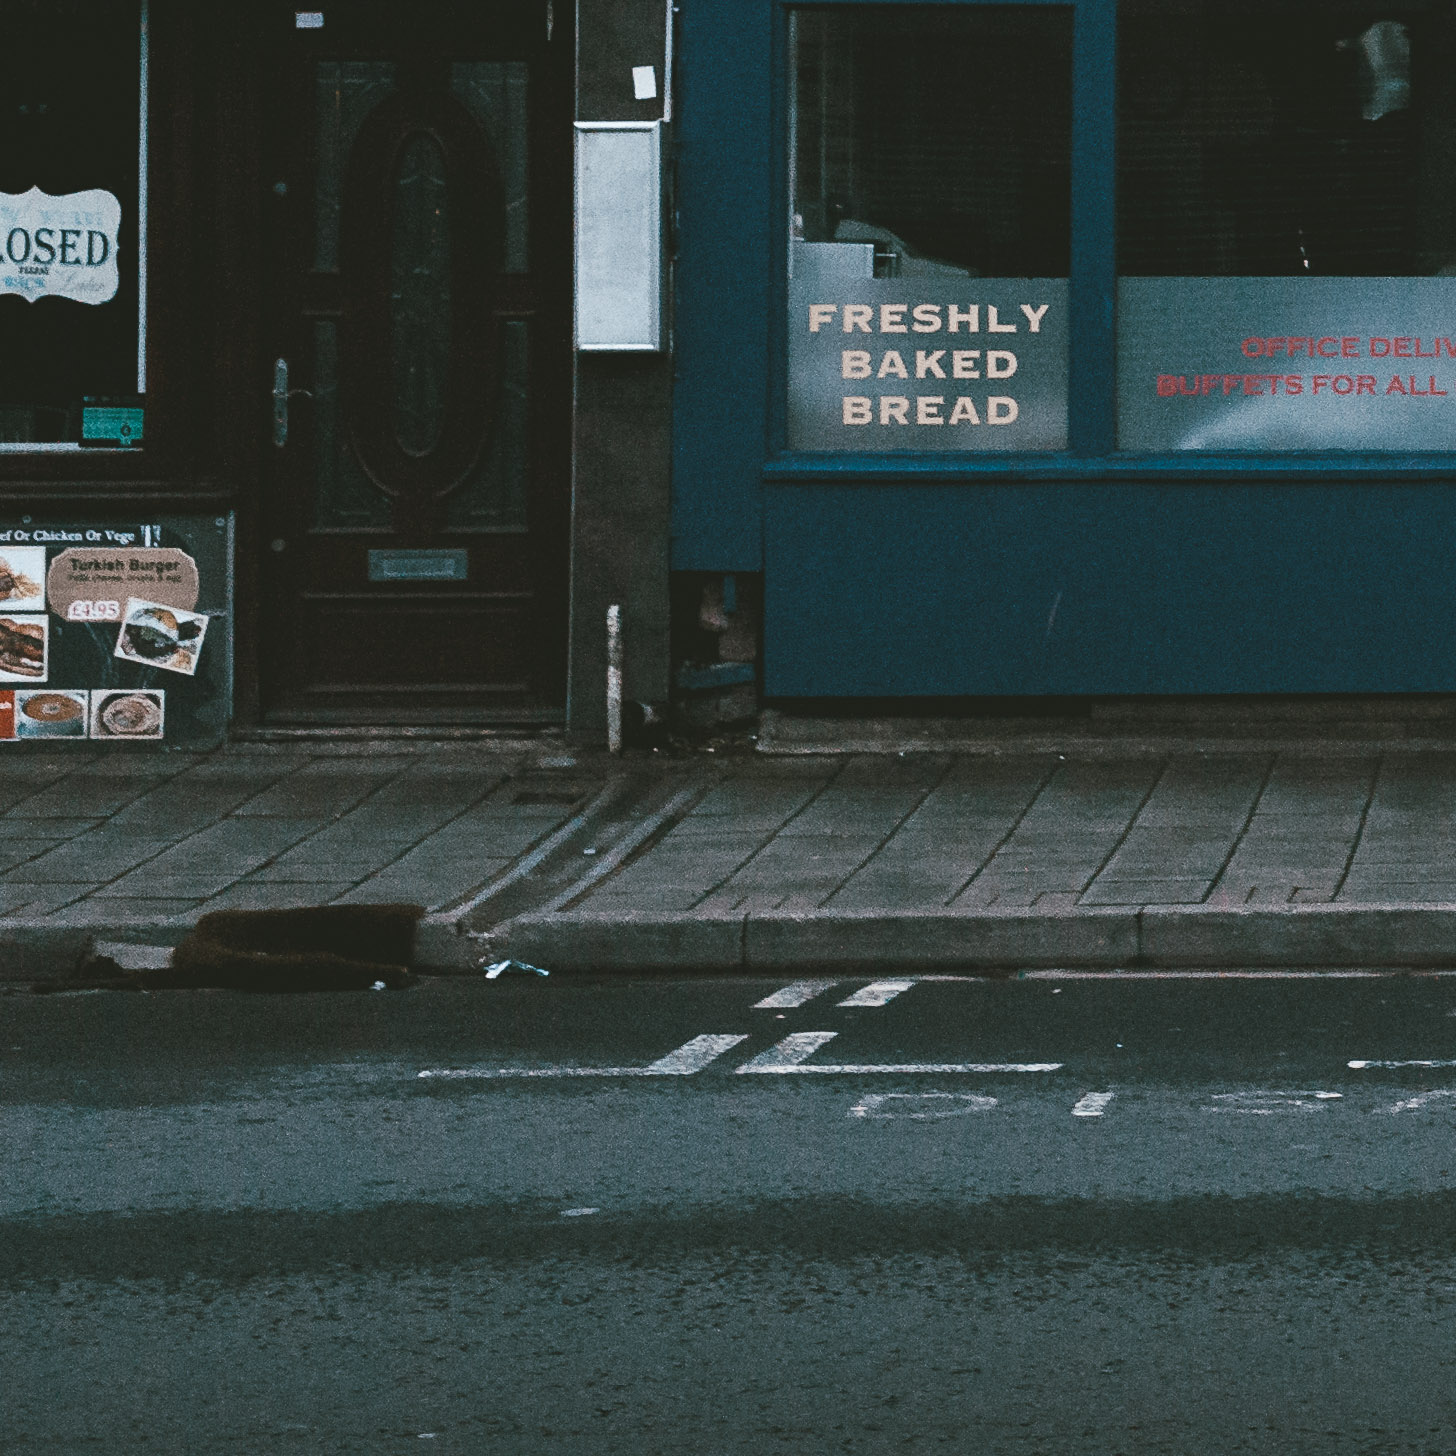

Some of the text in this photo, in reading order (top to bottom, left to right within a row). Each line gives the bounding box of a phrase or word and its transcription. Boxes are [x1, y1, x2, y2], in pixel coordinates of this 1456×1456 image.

[0, 227, 111, 267] OSED
[808, 303, 1049, 333] FRESHLY
[1240, 336, 1360, 359] OFFICE
[841, 349, 1018, 379] BAKED
[1156, 374, 1304, 397] BUFFETS
[1312, 374, 1378, 397] FOR
[1385, 374, 1449, 397] ALL
[842, 395, 1019, 425] BREAD
[14, 529, 30, 541] Or
[33, 529, 83, 542] Chicken
[86, 529, 102, 542] Or
[70, 557, 181, 574] Turkish Burger
